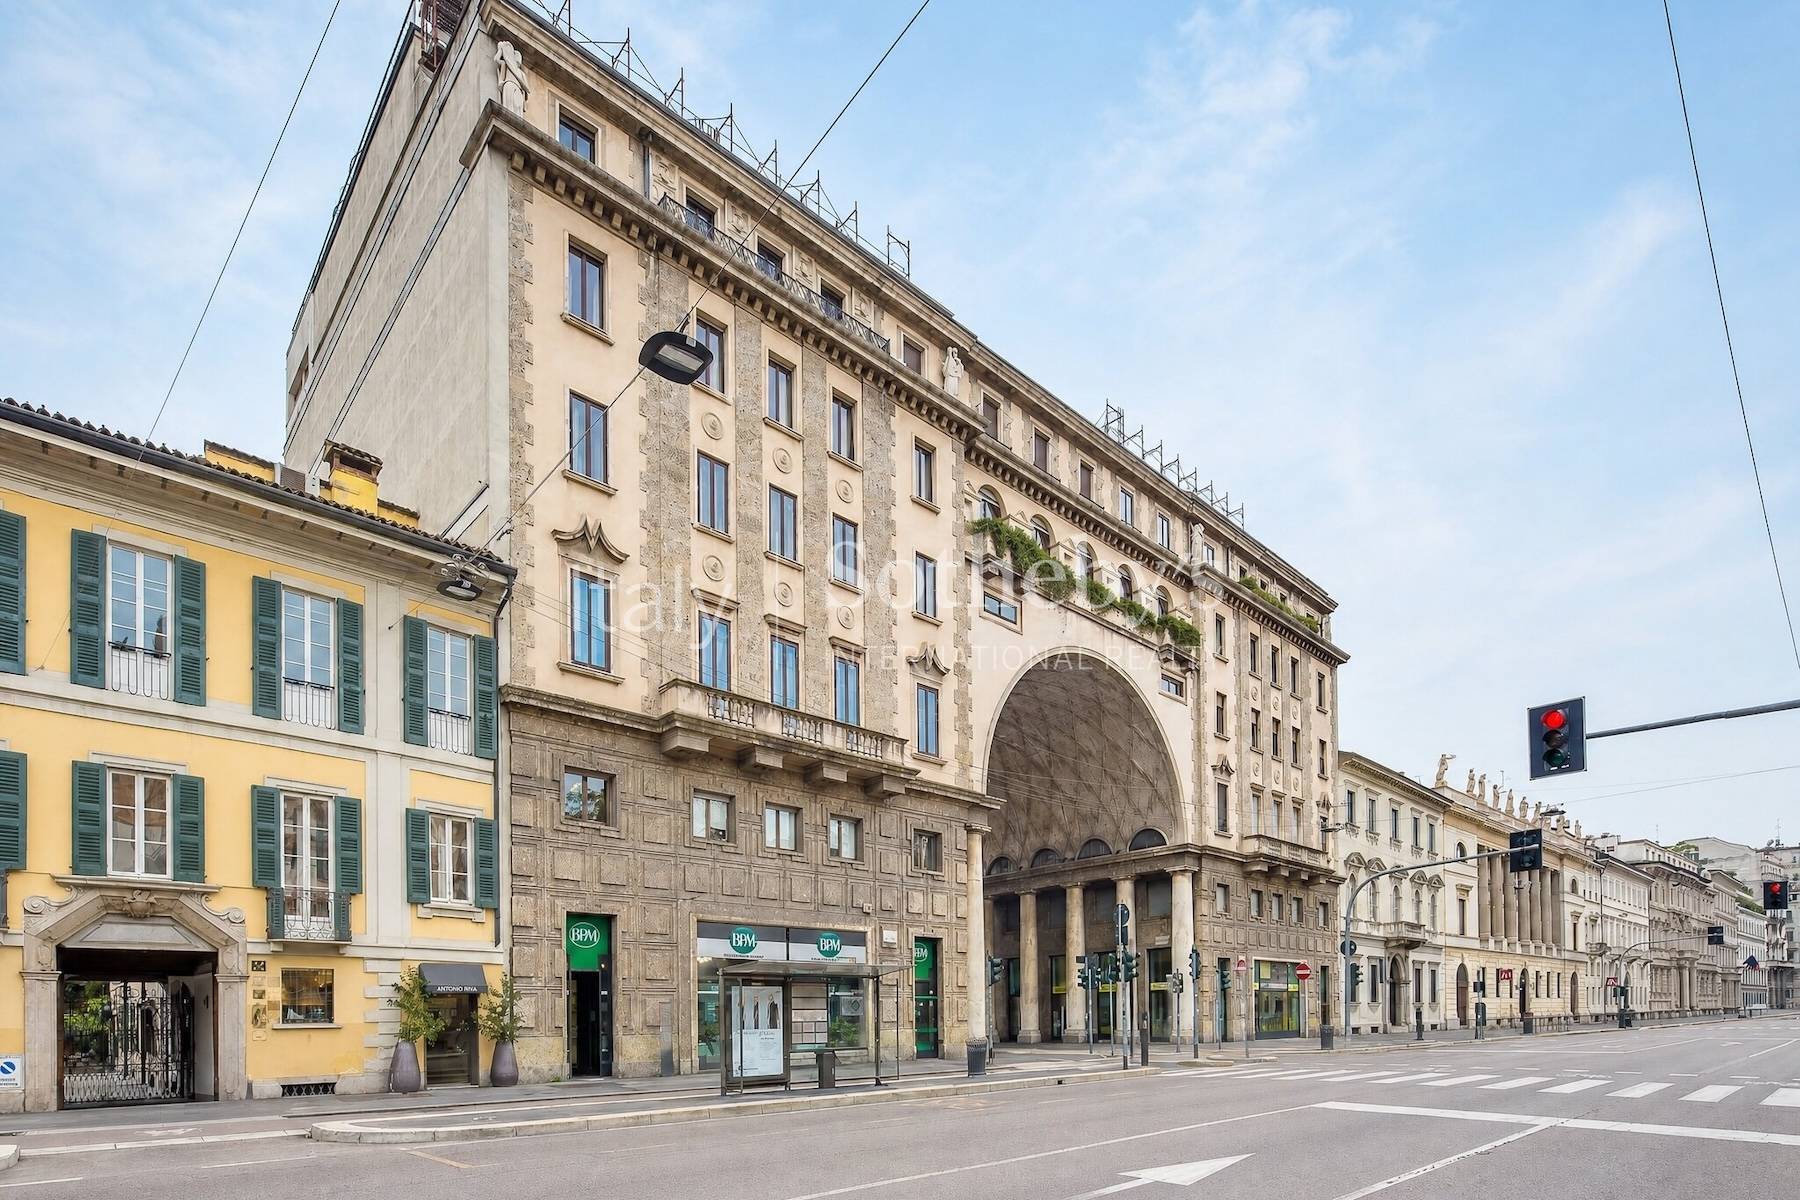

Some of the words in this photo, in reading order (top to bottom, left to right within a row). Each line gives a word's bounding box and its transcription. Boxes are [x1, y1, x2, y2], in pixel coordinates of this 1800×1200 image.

[571, 927, 598, 942] BPM
[732, 932, 757, 948] BPM
[819, 937, 842, 951] BPM
